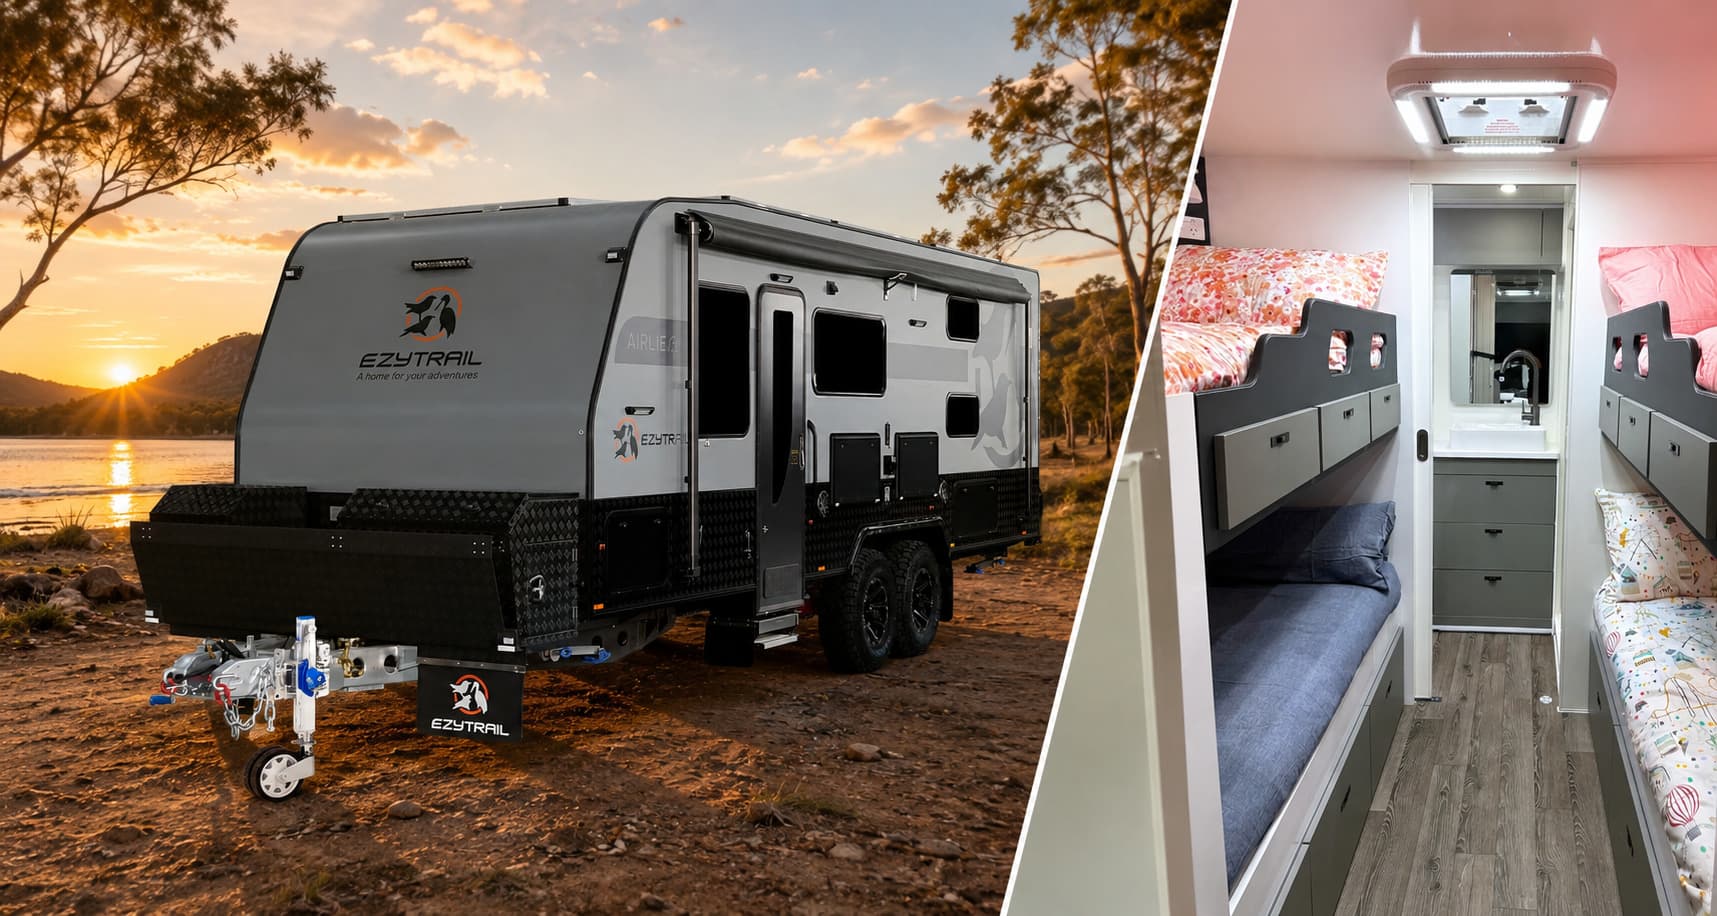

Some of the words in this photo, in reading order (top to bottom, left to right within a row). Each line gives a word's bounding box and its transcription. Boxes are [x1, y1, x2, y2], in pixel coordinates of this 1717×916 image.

[626, 333, 667, 352] AIRLIE
[359, 350, 482, 369] EZYTRAIL
[356, 371, 363, 381] A
[365, 371, 390, 381] home
[391, 370, 404, 380] for
[404, 372, 427, 382] your
[427, 370, 479, 380] adventures
[640, 432, 688, 446] EZYTRA
[431, 718, 510, 737] EZYTRAIL
